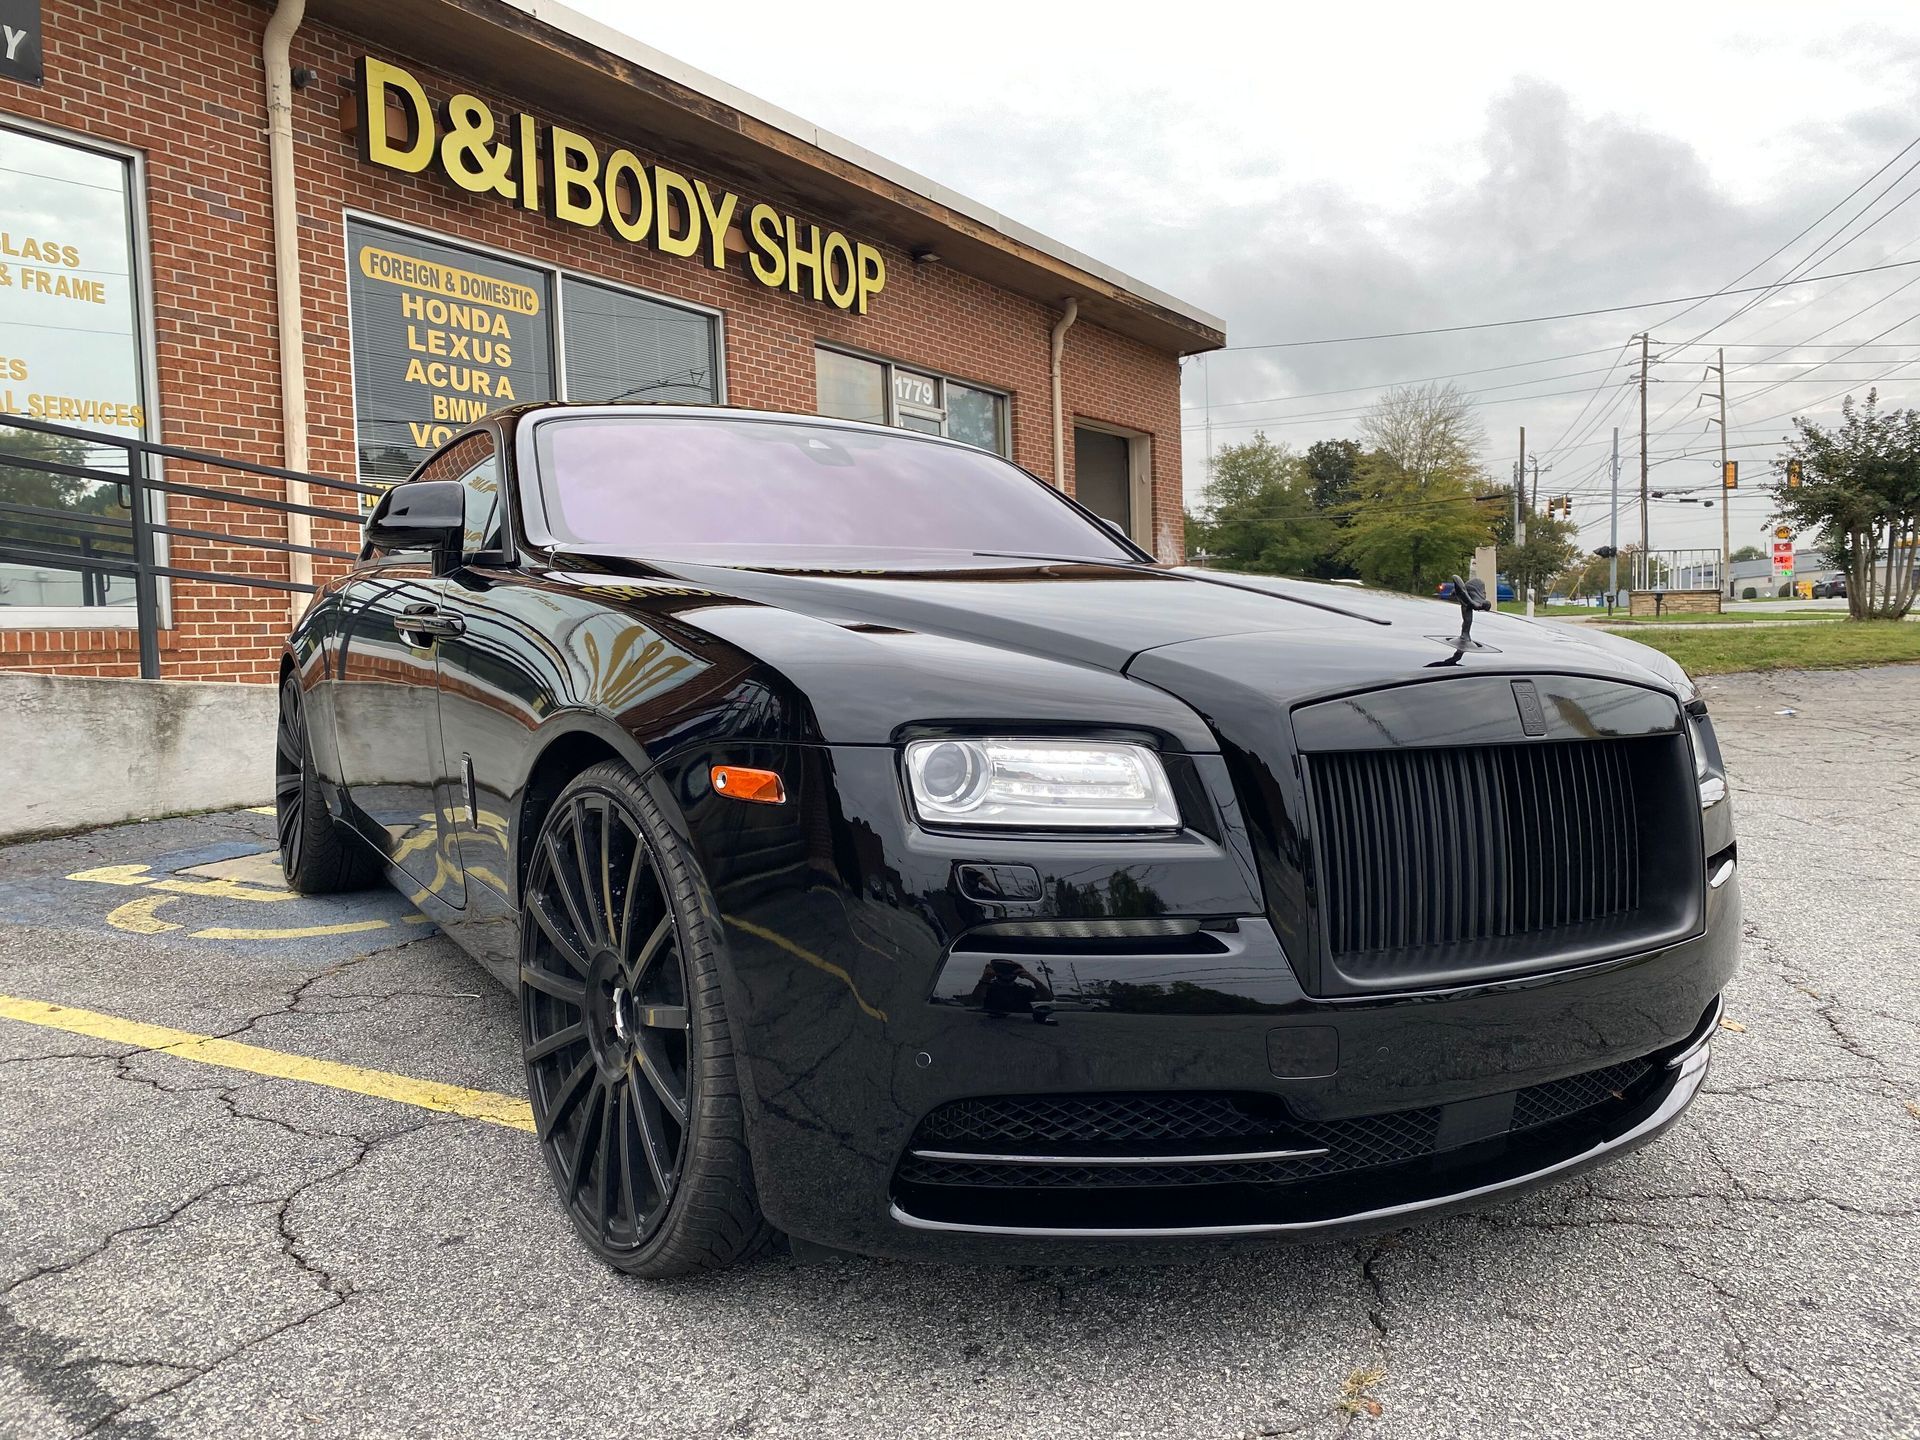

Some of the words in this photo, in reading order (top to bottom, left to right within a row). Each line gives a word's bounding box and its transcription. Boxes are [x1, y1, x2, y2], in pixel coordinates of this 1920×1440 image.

[364, 55, 537, 211] D&I
[551, 125, 738, 269] BODY
[748, 203, 887, 315] SHOP
[0, 233, 80, 268] LASS
[21, 268, 106, 304] FRAME
[370, 252, 440, 290] FOREIGN
[444, 273, 456, 293] &
[460, 275, 533, 311] DOMESTIC
[402, 292, 511, 339] HONDA
[407, 325, 512, 368] LEXUS
[404, 358, 516, 400] ACURA
[895, 376, 933, 405] 1779
[27, 393, 145, 428] SERVICES
[433, 395, 488, 424] BMW
[408, 422, 462, 448] VO
